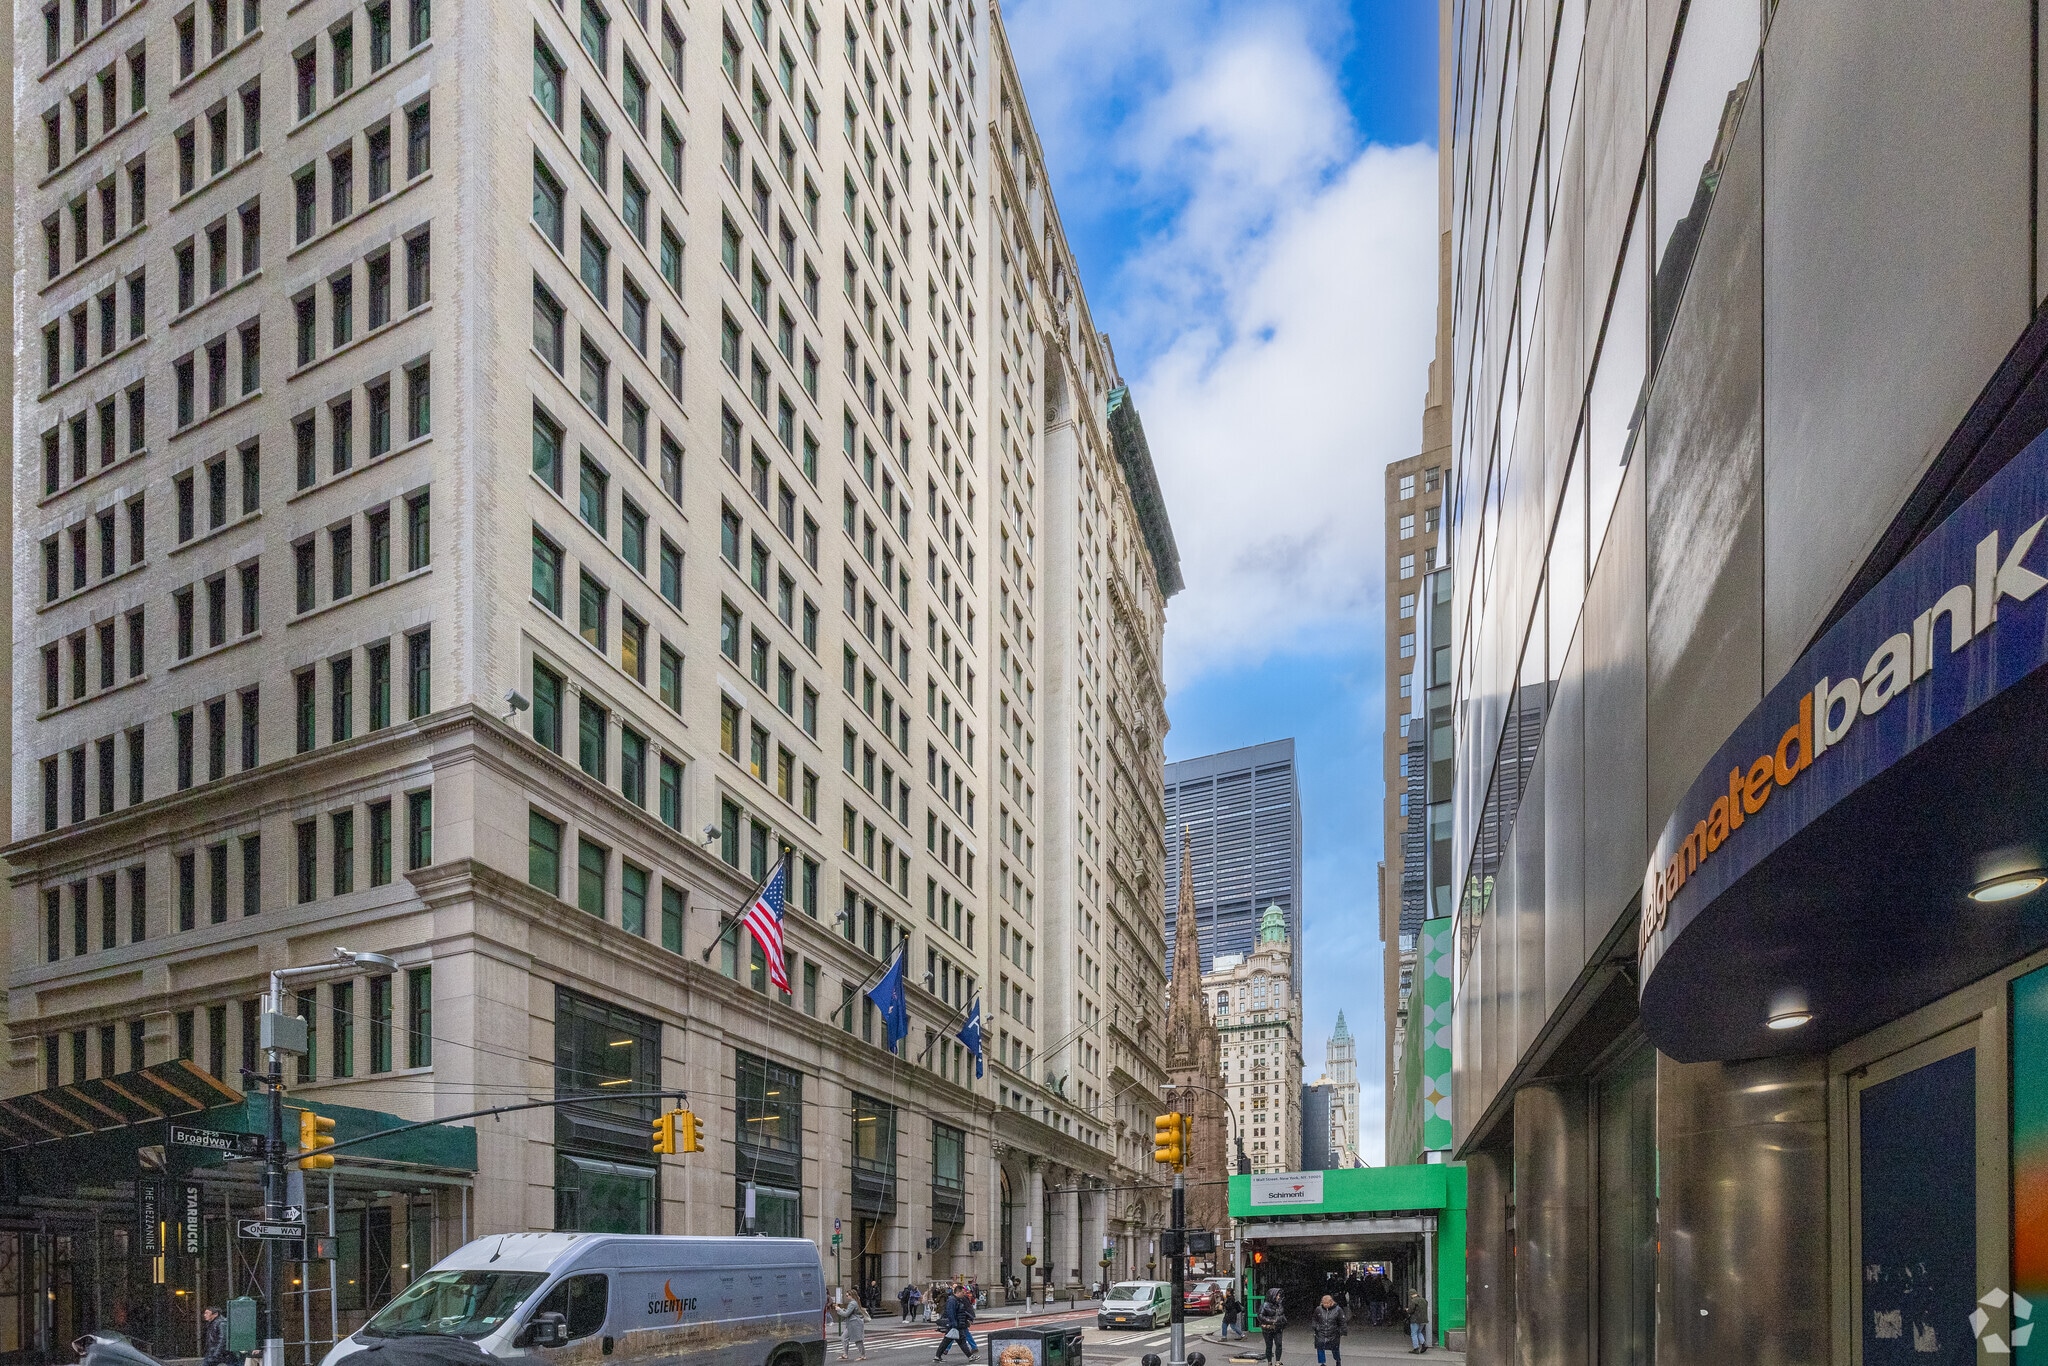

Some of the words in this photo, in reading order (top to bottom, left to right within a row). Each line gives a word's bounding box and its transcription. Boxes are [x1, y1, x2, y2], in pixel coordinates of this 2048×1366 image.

[177, 1131, 232, 1149] Broadway
[145, 1187, 154, 1200] THE
[1268, 1191, 1304, 1199] Schimenti
[145, 1202, 154, 1250] MEZZANINE
[187, 1187, 198, 1253] STARBUCKS
[250, 1225, 269, 1234] ONE
[280, 1227, 299, 1235] WAY
[647, 1297, 697, 1315] SCIENTIFIC
